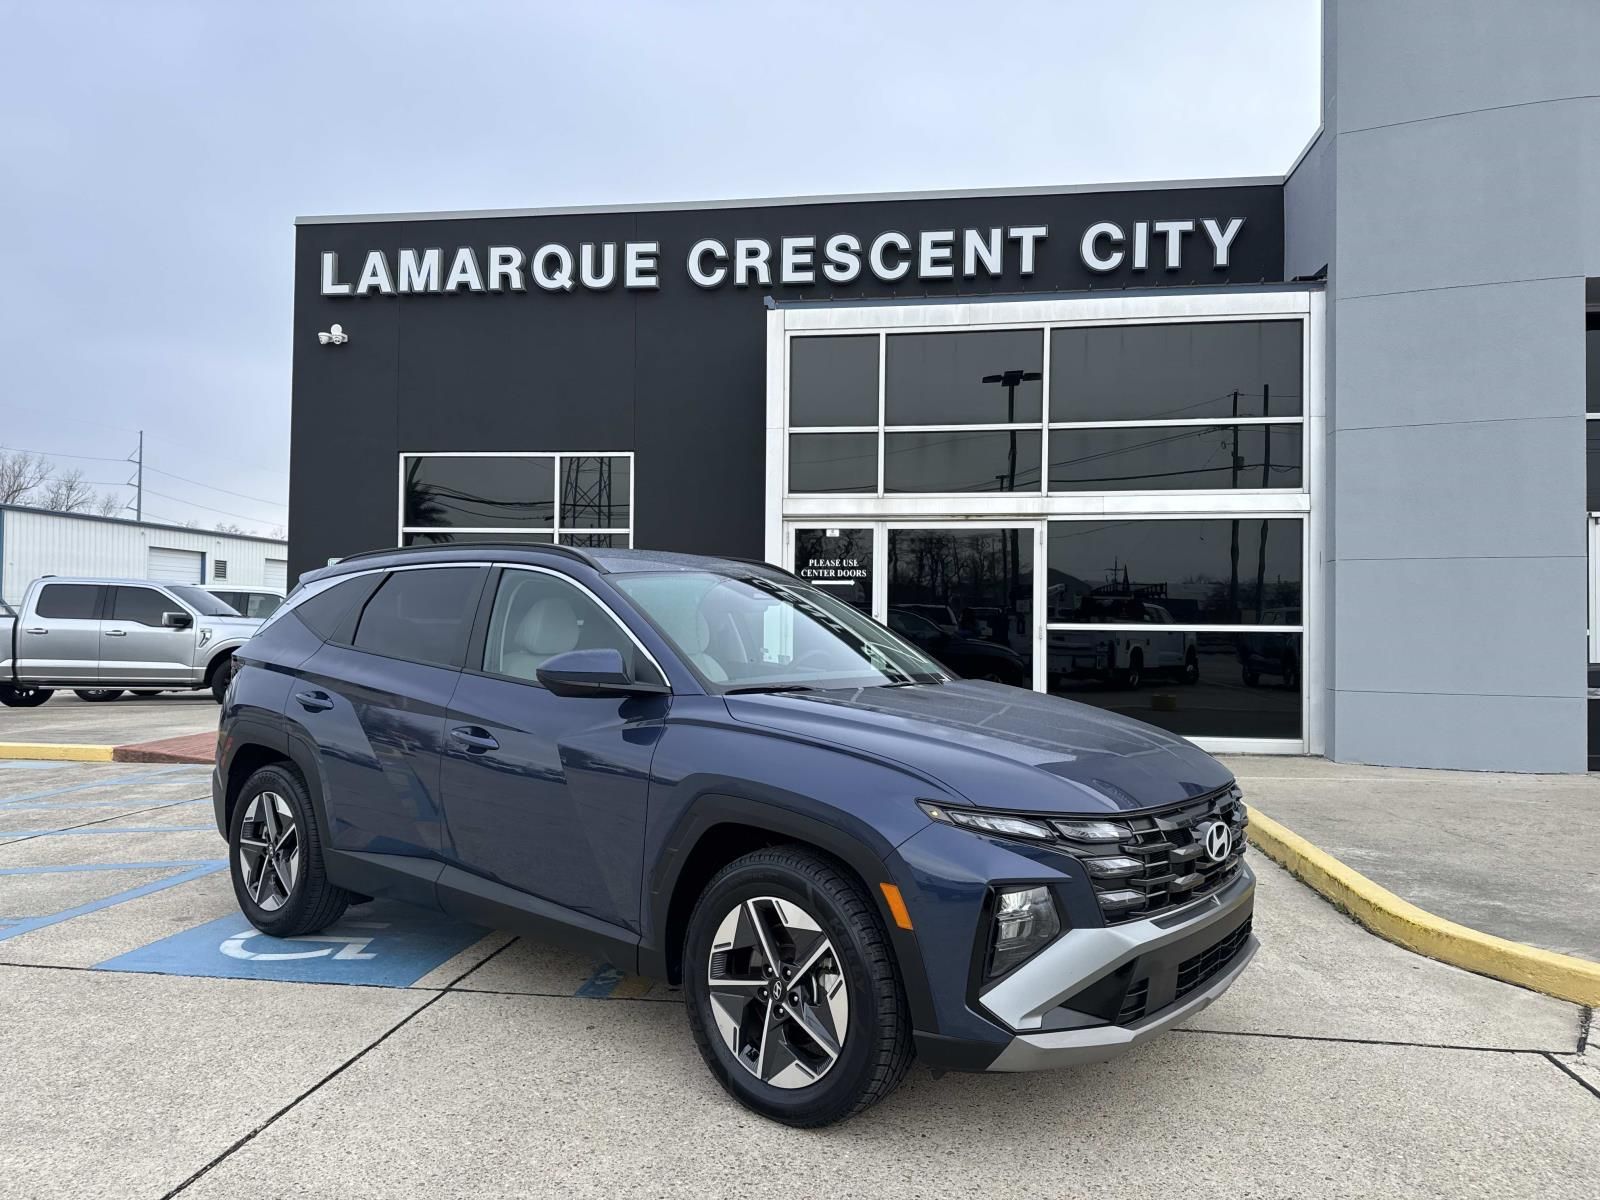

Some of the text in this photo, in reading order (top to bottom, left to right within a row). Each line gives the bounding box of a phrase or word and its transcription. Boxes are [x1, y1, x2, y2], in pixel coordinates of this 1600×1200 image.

[320, 217, 1245, 296] LAMARQUE CRESCENT CITY
[809, 559, 859, 567] PLEASE USE
[801, 569, 867, 577] CENTER DOORS
